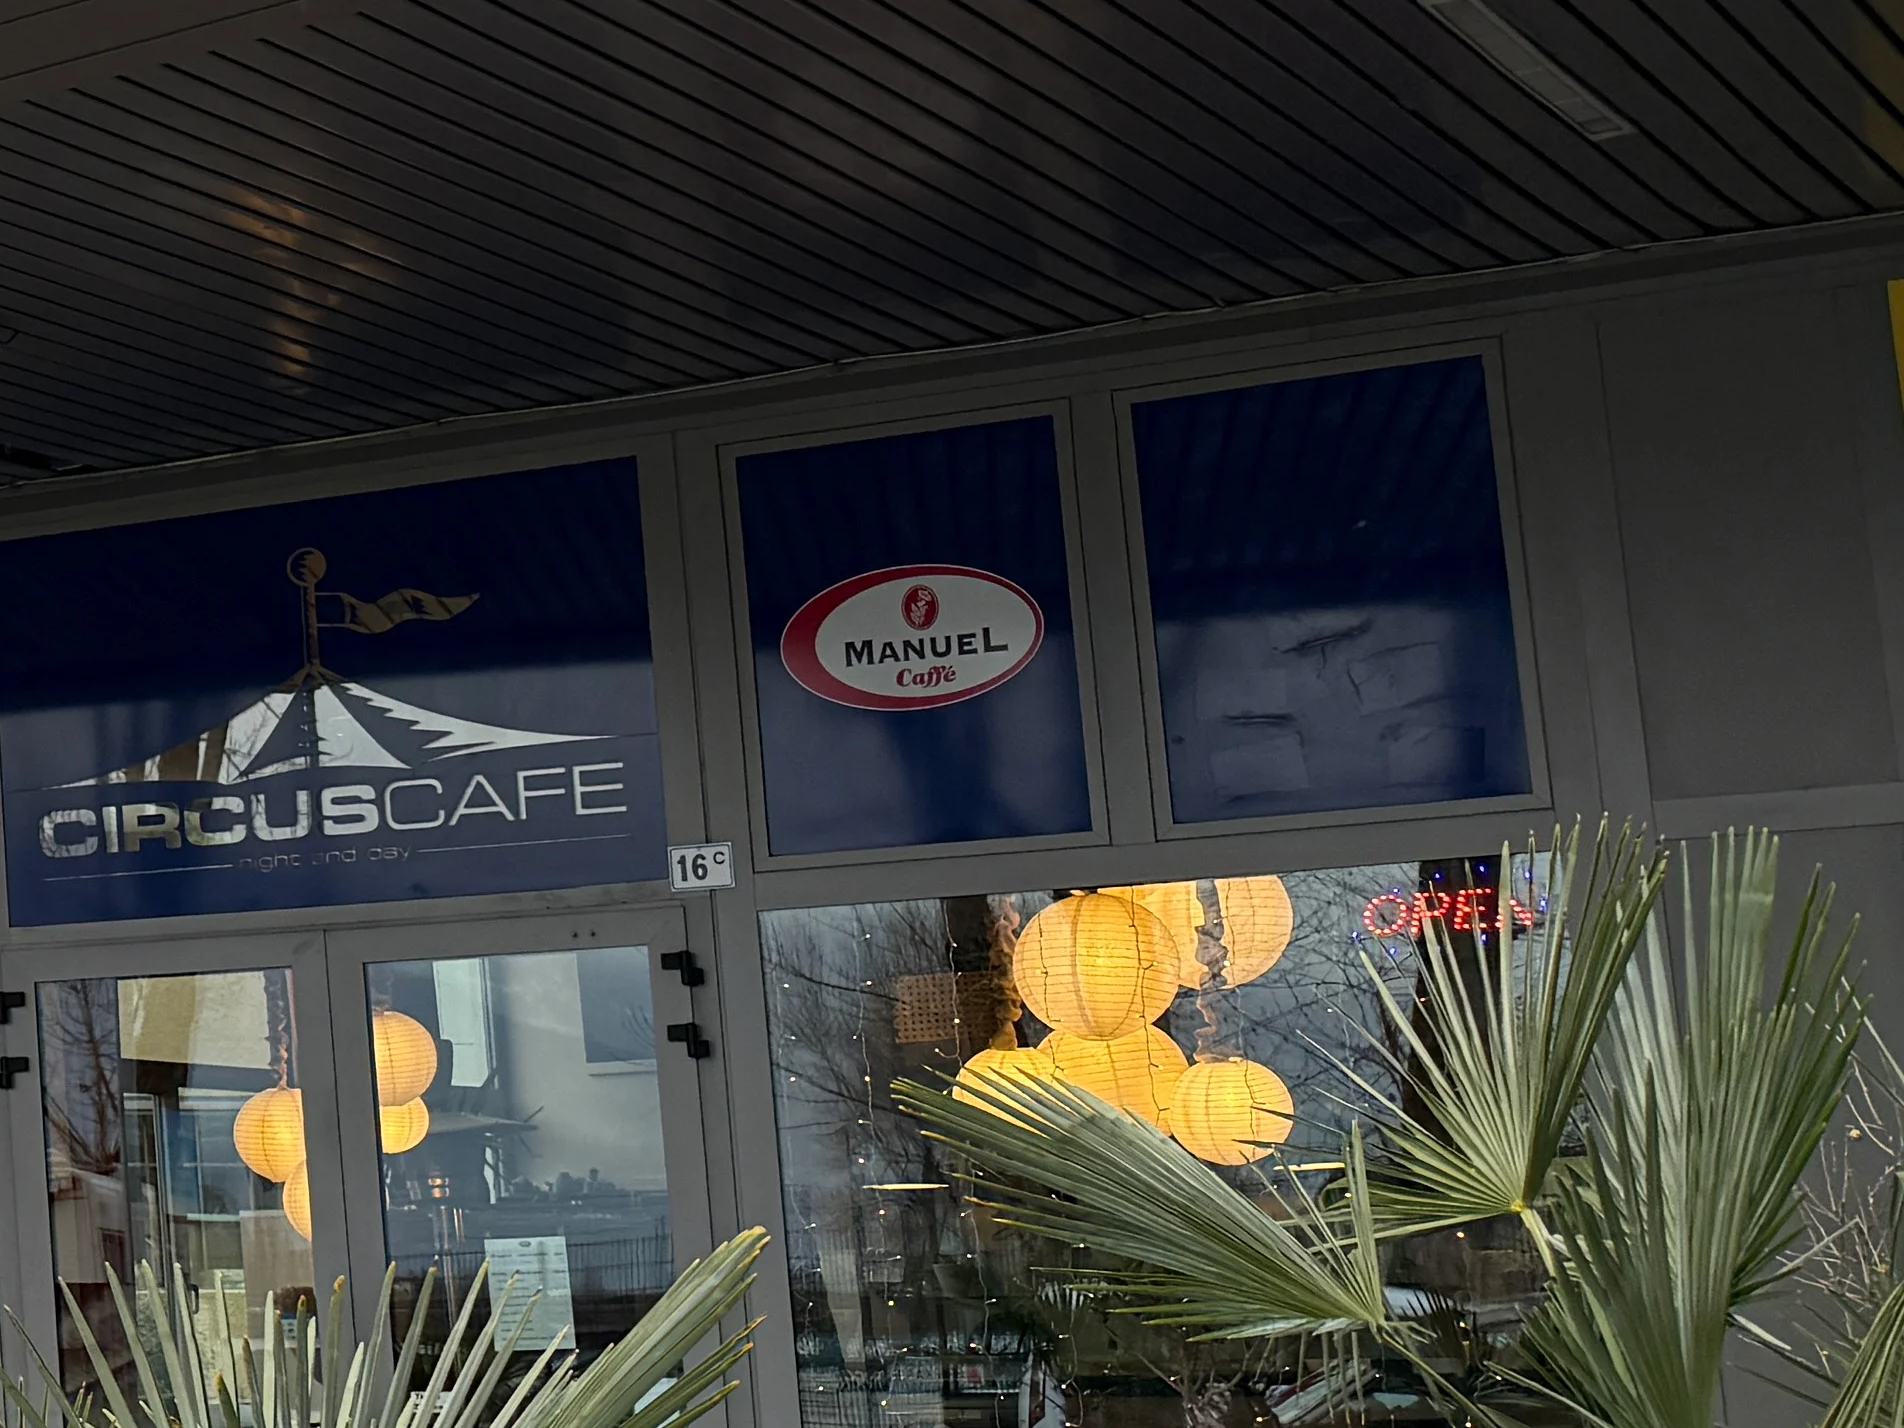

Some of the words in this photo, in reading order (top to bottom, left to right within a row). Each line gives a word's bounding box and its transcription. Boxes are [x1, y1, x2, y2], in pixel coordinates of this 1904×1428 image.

[844, 627, 1009, 668] MANUEL
[895, 665, 957, 689] Caffé
[39, 761, 627, 858] CIRCUSCAFE
